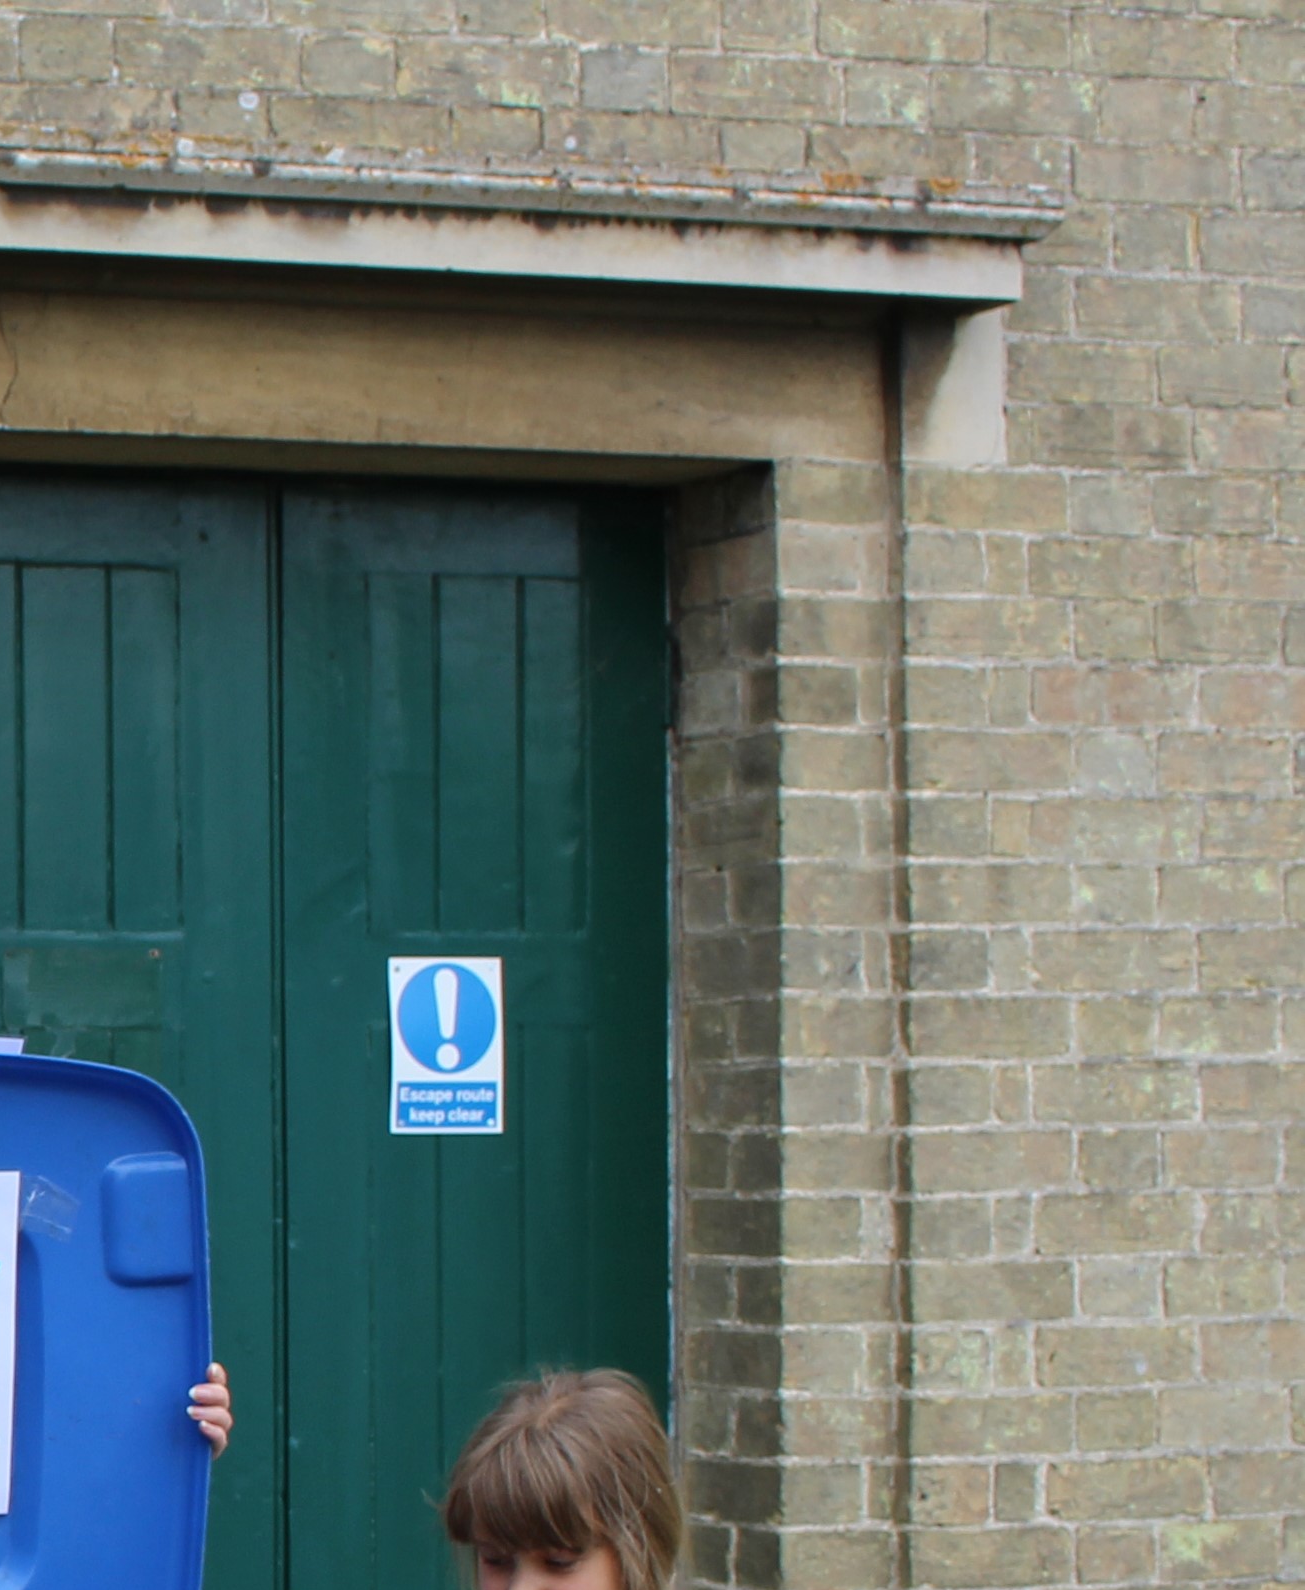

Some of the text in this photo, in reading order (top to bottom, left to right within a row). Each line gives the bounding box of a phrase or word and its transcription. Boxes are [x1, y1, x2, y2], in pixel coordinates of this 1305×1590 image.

[399, 1087, 494, 1104] Escape route
[409, 1107, 485, 1124] keep clear
